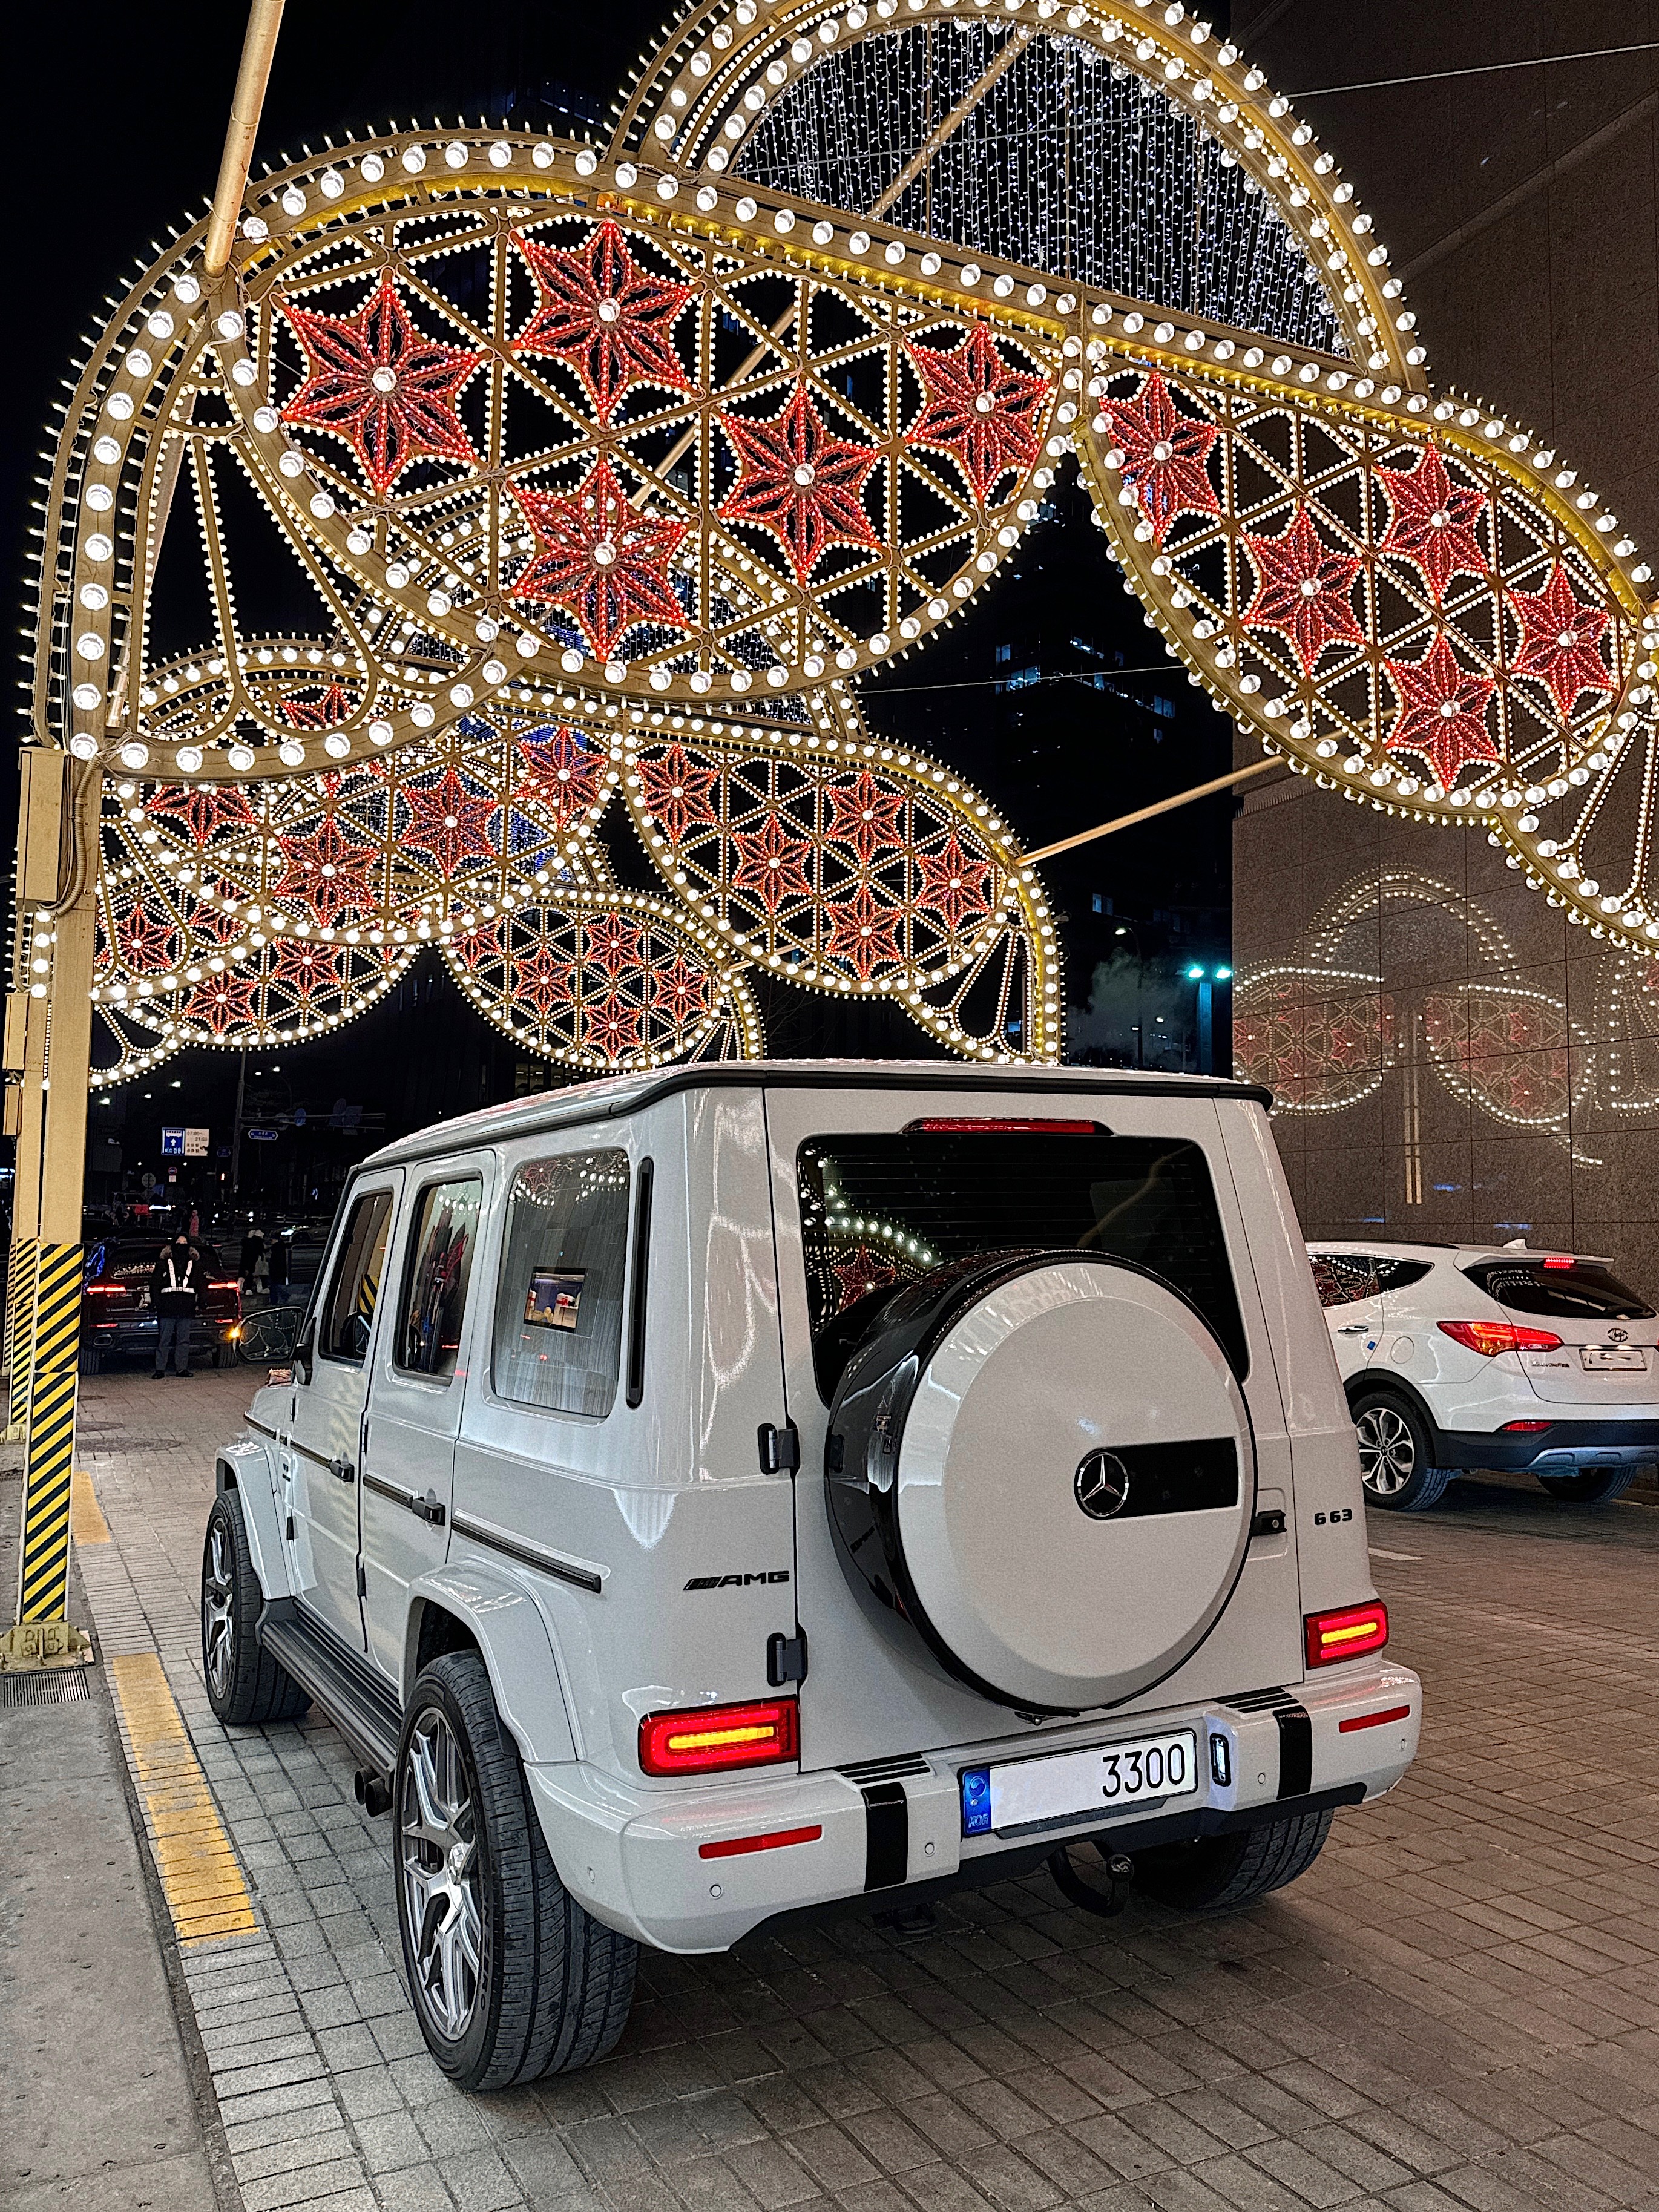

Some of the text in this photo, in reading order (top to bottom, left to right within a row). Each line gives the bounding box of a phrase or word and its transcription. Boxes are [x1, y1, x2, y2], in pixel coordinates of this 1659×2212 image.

[1314, 1508, 1352, 1525] G 63
[717, 1570, 789, 1587] AMG
[1102, 1744, 1185, 1797] 3300
[968, 1813, 989, 1828] KOR
